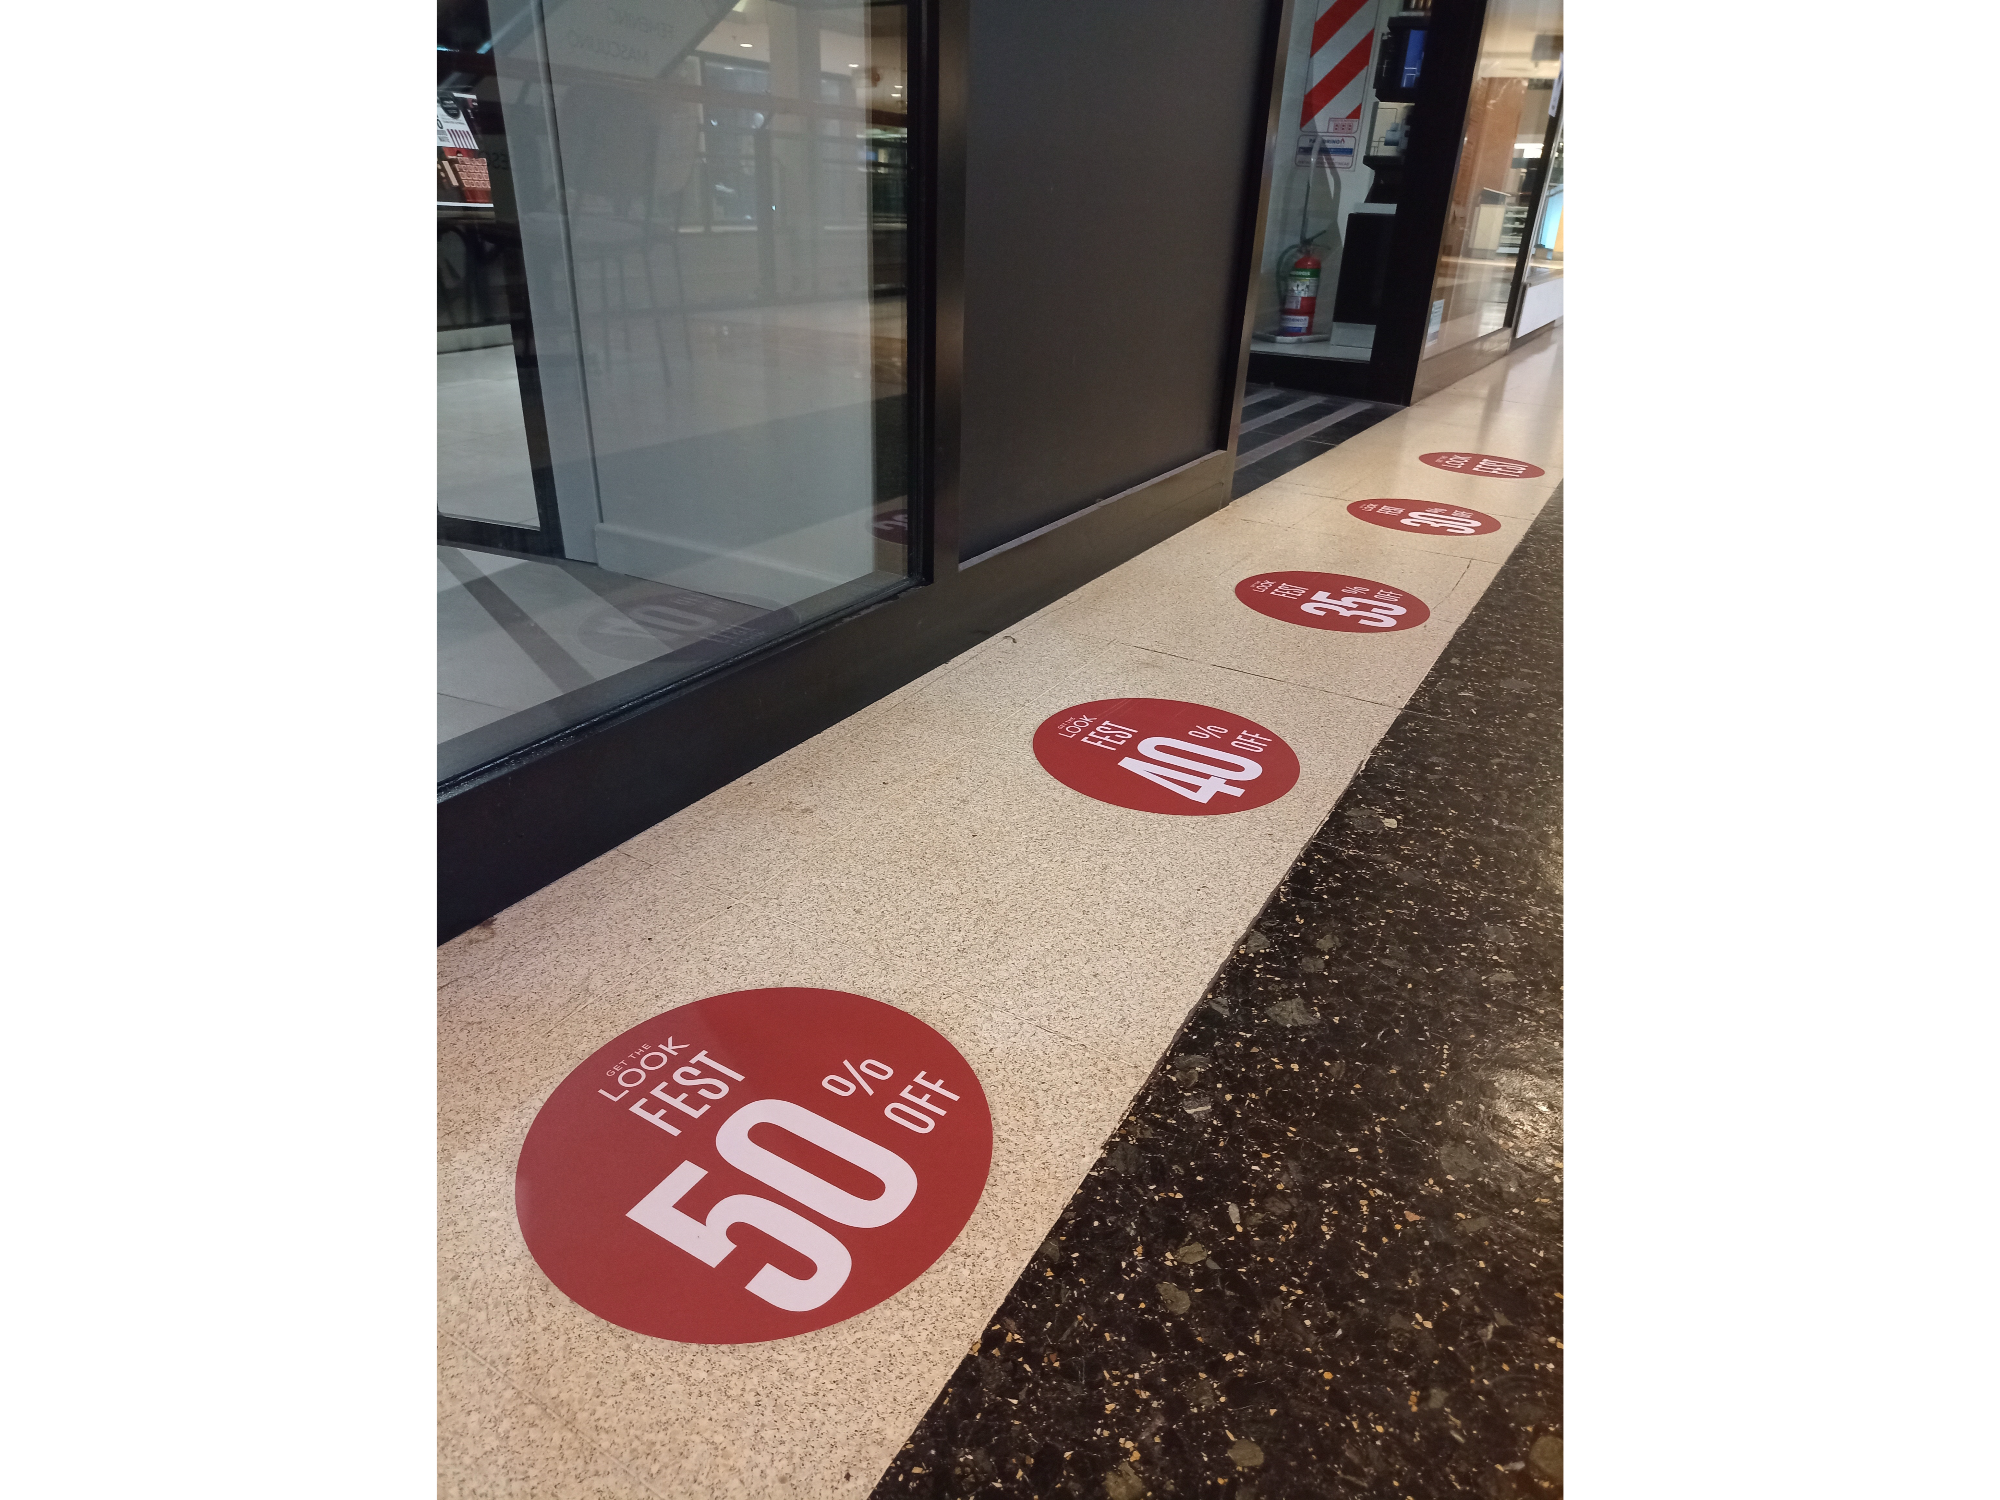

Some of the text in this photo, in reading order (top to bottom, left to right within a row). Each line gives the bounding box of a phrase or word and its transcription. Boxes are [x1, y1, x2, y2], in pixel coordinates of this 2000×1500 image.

[1441, 454, 1473, 469] LOOK
[1471, 458, 1530, 478] FEST
[1400, 510, 1482, 536] 30
[1253, 579, 1277, 593] LOOK
[1270, 583, 1309, 600] FEST
[1341, 586, 1370, 595] %
[1374, 589, 1405, 602] OFF
[1300, 591, 1408, 628] 35
[1059, 715, 1098, 738] LOOK
[1081, 721, 1138, 751] FEST
[1188, 724, 1229, 739] %
[1231, 730, 1273, 753] OFF
[1118, 736, 1263, 804] 40
[597, 1035, 691, 1103] LOOK
[606, 1043, 653, 1077] GET THE
[821, 1058, 894, 1097] %
[628, 1049, 746, 1137] FEST
[883, 1071, 961, 1134] OFF
[625, 1098, 918, 1313] 50
